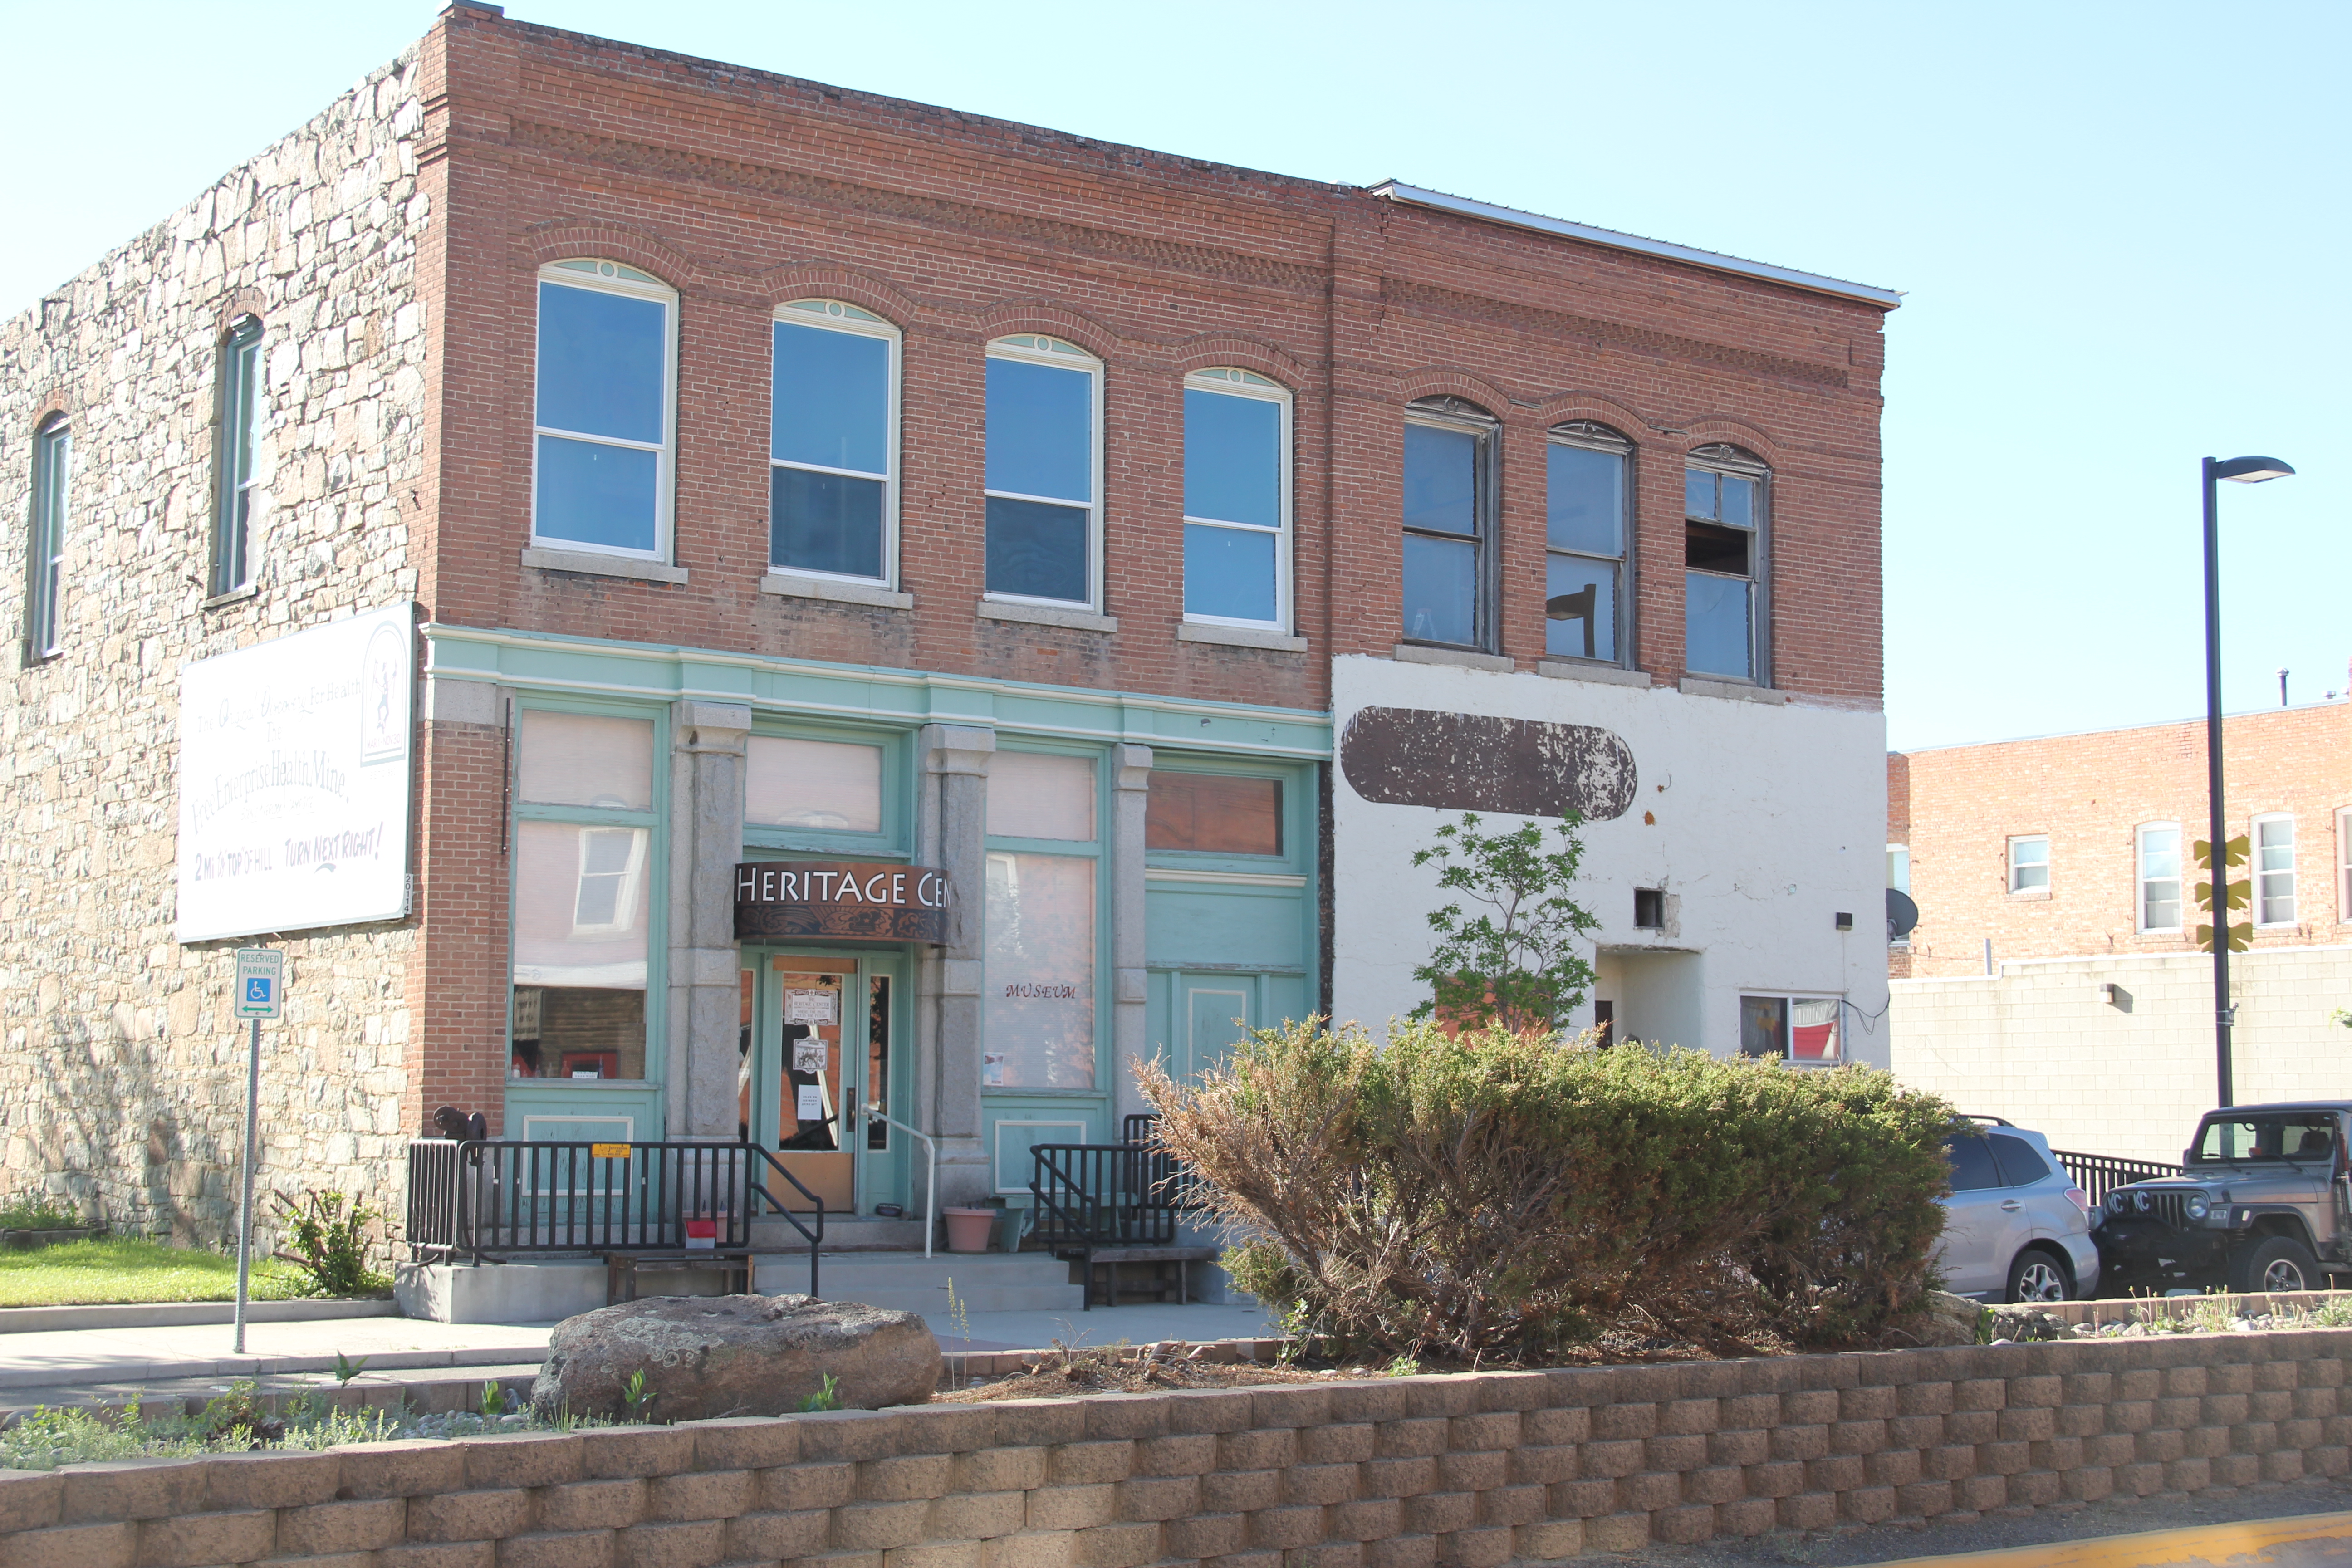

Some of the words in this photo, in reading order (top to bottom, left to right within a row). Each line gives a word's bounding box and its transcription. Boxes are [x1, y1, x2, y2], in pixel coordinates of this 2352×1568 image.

[198, 715, 214, 733] The
[310, 686, 325, 706] For
[327, 677, 361, 701] Health
[267, 721, 282, 743] The
[191, 794, 215, 837] Free
[215, 760, 270, 811] Enterprise
[271, 749, 309, 786] Health
[195, 853, 202, 881] 2
[244, 849, 253, 875] OF
[255, 847, 272, 872] HILL
[285, 838, 311, 867] TURN
[314, 833, 340, 862] NEXT
[737, 867, 906, 904] HERITAGE
[241, 954, 279, 964] RESERVED
[243, 966, 276, 975] PARKING
[1006, 983, 1076, 999] MUSEUM
[2107, 1192, 2123, 1214] KC
[2133, 1190, 2149, 1211] KC
